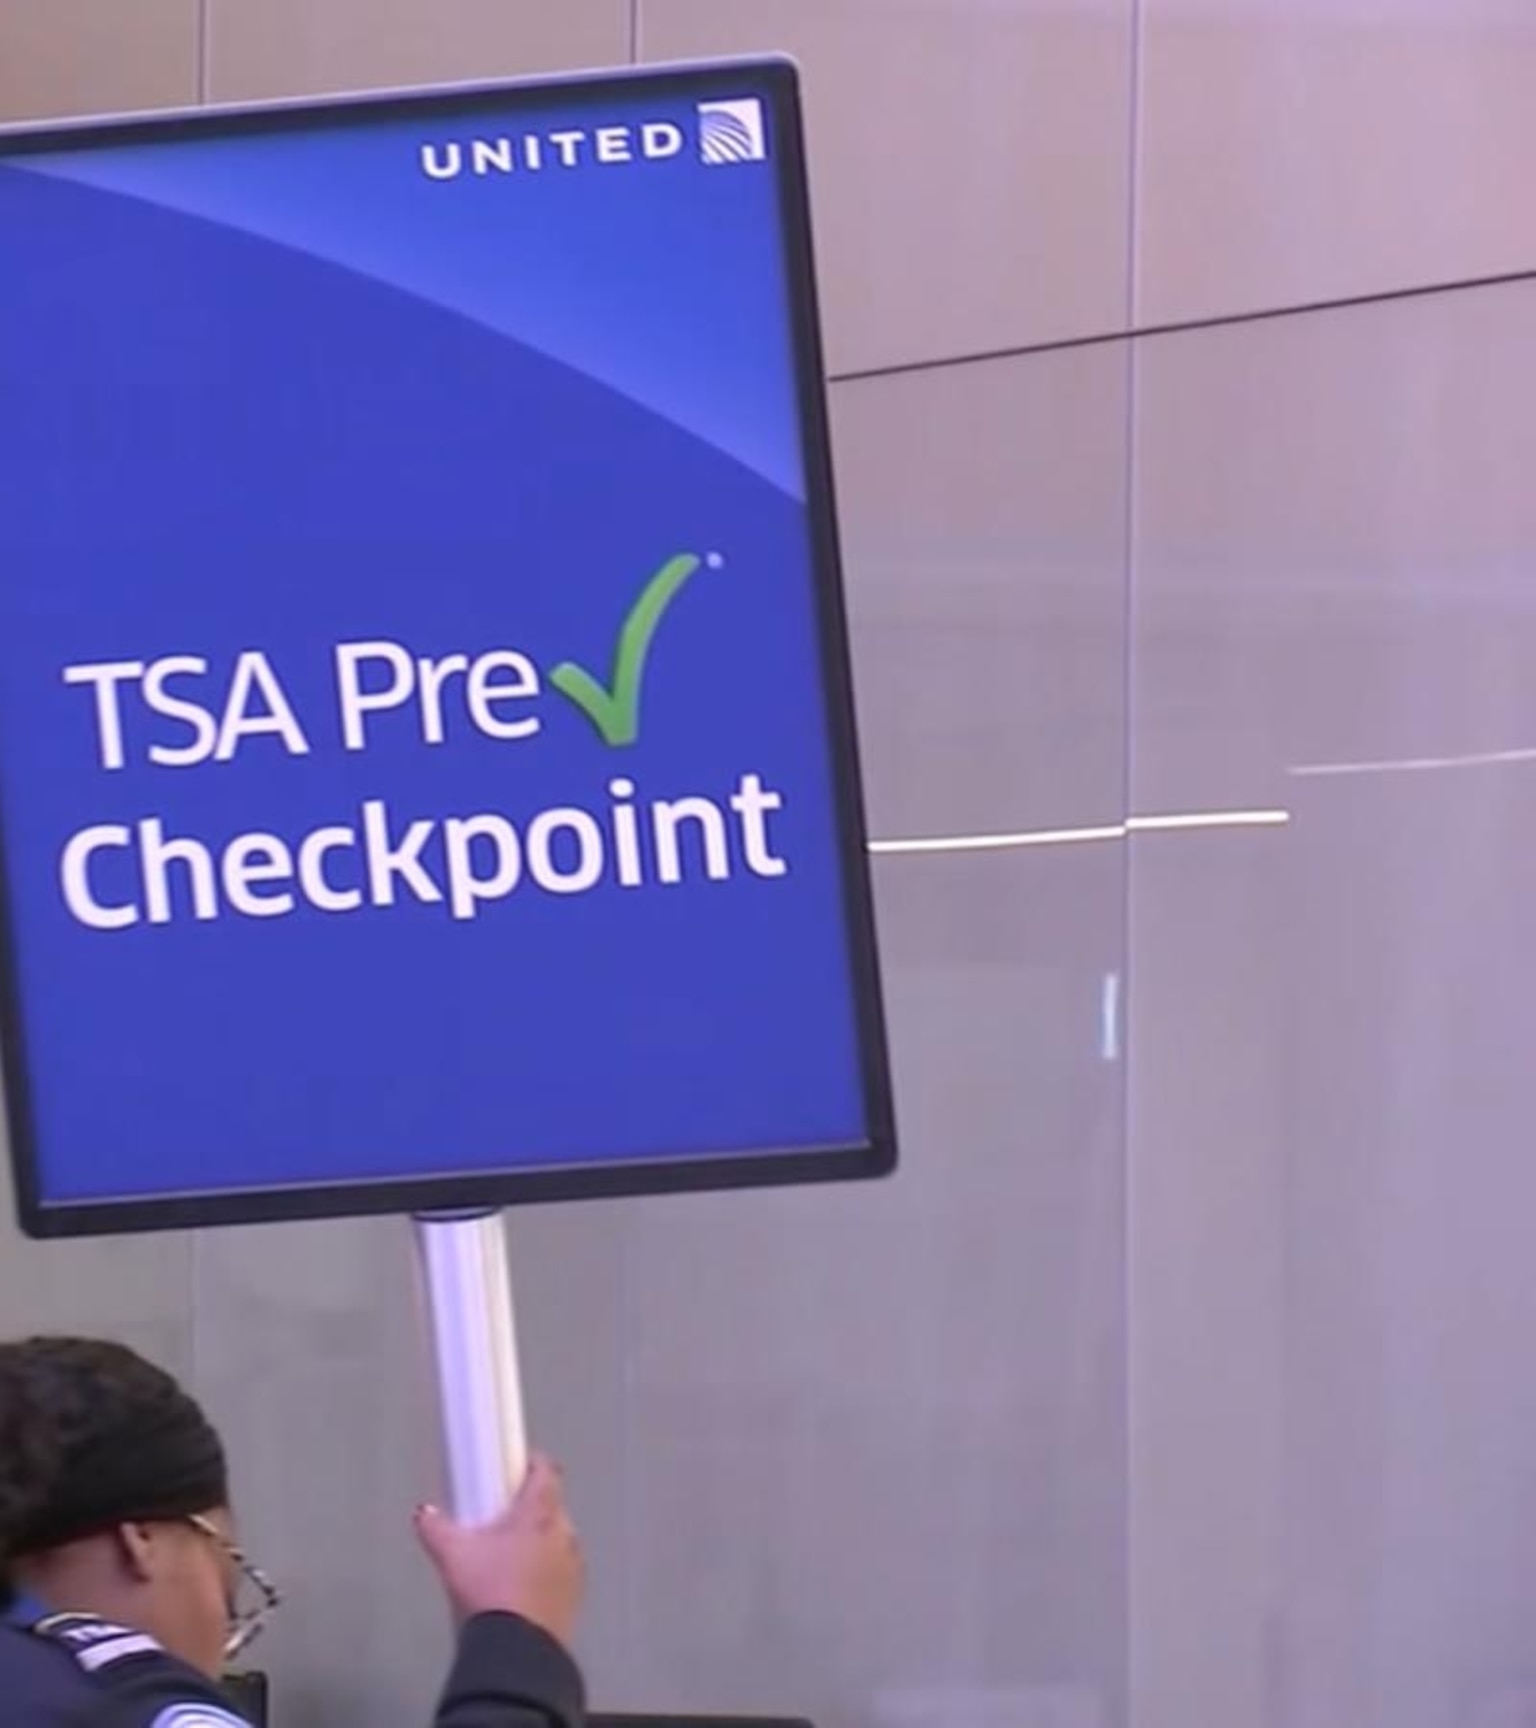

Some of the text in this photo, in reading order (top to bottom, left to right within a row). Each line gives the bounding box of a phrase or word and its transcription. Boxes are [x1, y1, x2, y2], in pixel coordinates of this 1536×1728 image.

[421, 122, 683, 179] UNITED
[63, 640, 542, 770] TSA Pre
[60, 773, 787, 929] Checkpoint
